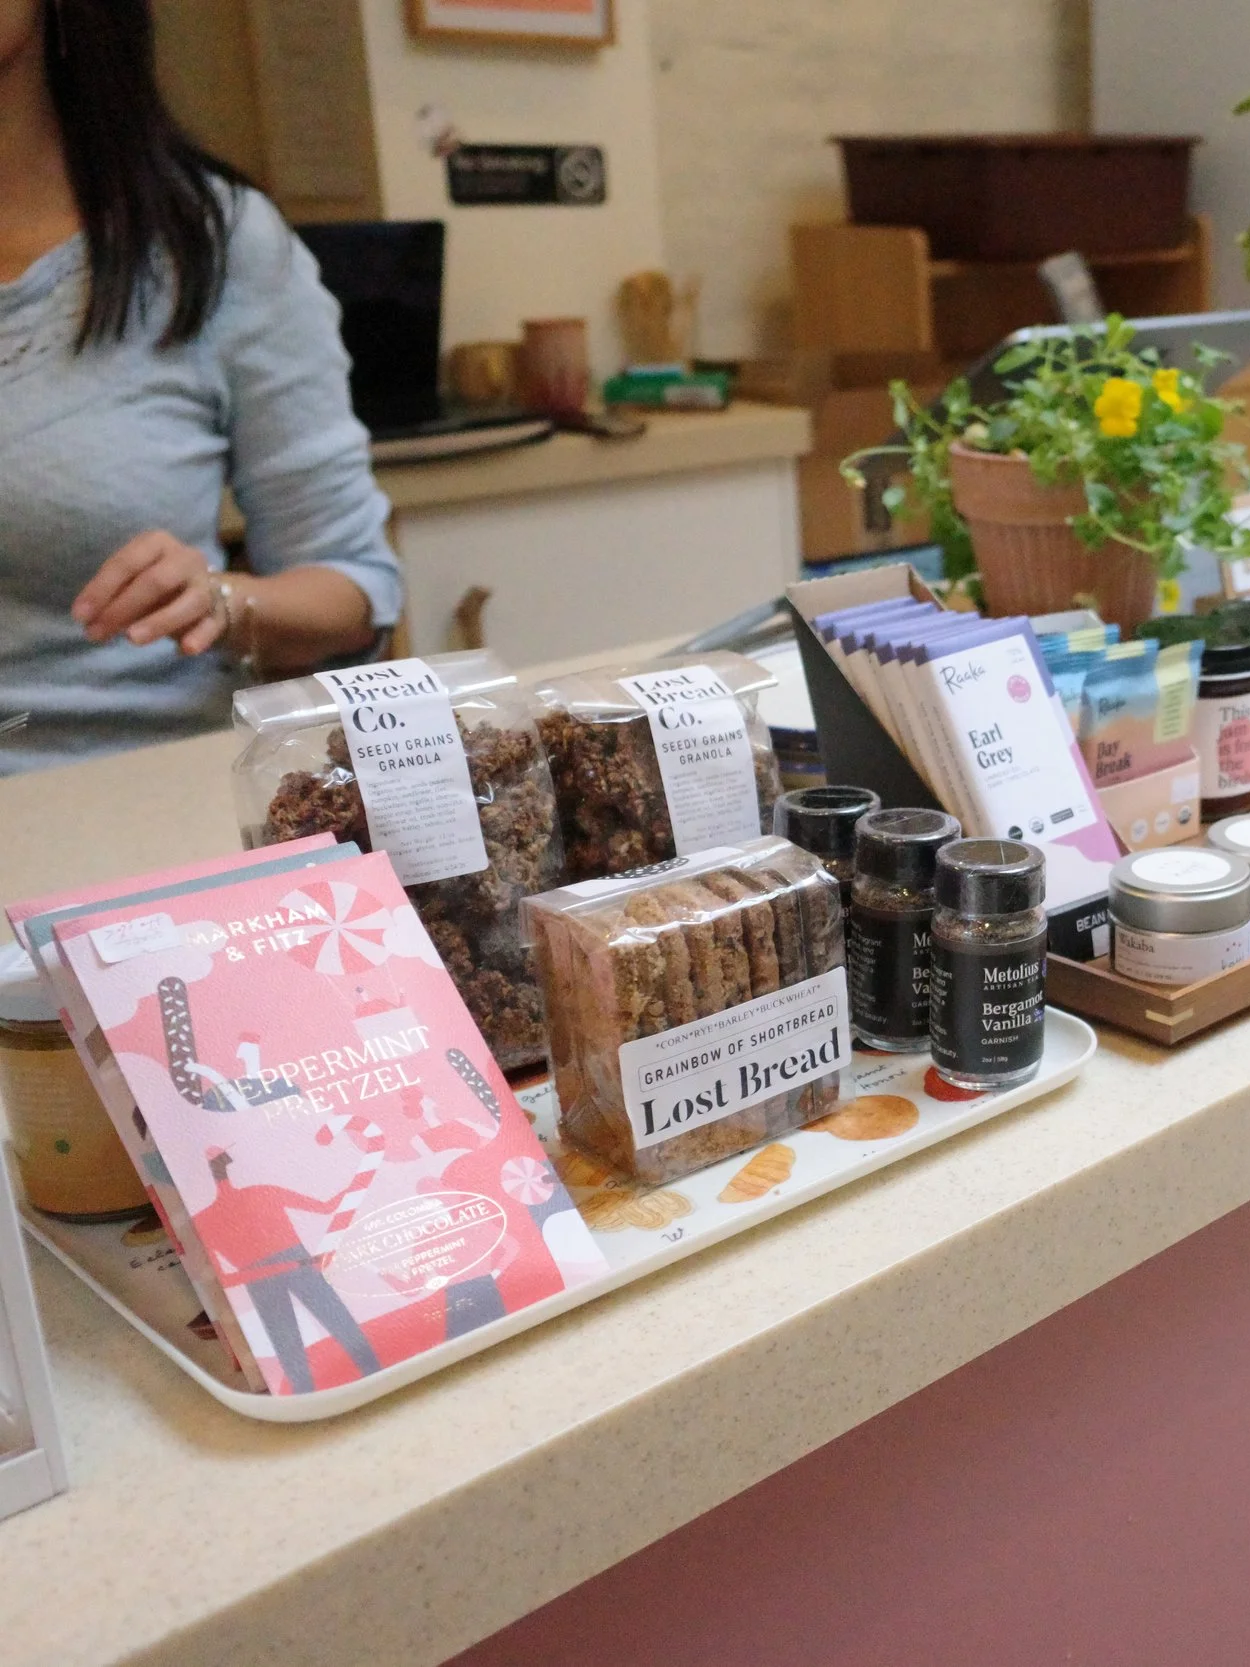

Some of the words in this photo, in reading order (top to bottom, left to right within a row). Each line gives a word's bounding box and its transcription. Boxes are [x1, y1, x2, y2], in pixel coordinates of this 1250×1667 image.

[330, 668, 402, 685] Lost
[632, 674, 695, 693] Lost
[939, 662, 987, 695] Raaka
[339, 674, 440, 705] Bread
[645, 682, 727, 706] Bread
[352, 706, 406, 733] Co.
[658, 706, 703, 730] Co.
[357, 741, 400, 759] SEEDY
[405, 733, 454, 750] GRAINS
[661, 737, 697, 753] SEEDY
[702, 729, 743, 746] GRAINS
[968, 722, 1003, 749] Earl
[1217, 740, 1231, 753] is
[679, 748, 732, 765] GRANOLA
[976, 746, 1014, 770] Grey
[1097, 740, 1120, 759] Day
[379, 752, 442, 772] GRANOLA
[1096, 752, 1132, 779] Break
[1219, 759, 1243, 772] the
[186, 902, 328, 948] MARKHAM
[1076, 913, 1106, 932] BEAN
[225, 945, 246, 963] &
[252, 928, 311, 957] FITZ
[1119, 932, 1154, 953] Wakaba
[983, 961, 1039, 984] Metolius
[983, 981, 1023, 991] ARTISAN
[982, 990, 1043, 1017] Bergamot
[982, 1013, 1031, 1032] Vanilla
[644, 1047, 721, 1085] GRAINBOW
[728, 1039, 744, 1055] OF
[750, 1004, 834, 1047] SHORTBREAD
[981, 1035, 1019, 1046] GARNISH
[264, 1062, 422, 1123] PRETZEL
[640, 1079, 729, 1136] Lost
[738, 1026, 840, 1100] Bread
[382, 1201, 490, 1249] CHOCOLATE
[402, 1237, 466, 1267] PEPPERMINT
[411, 1255, 456, 1276] PRETZEL
